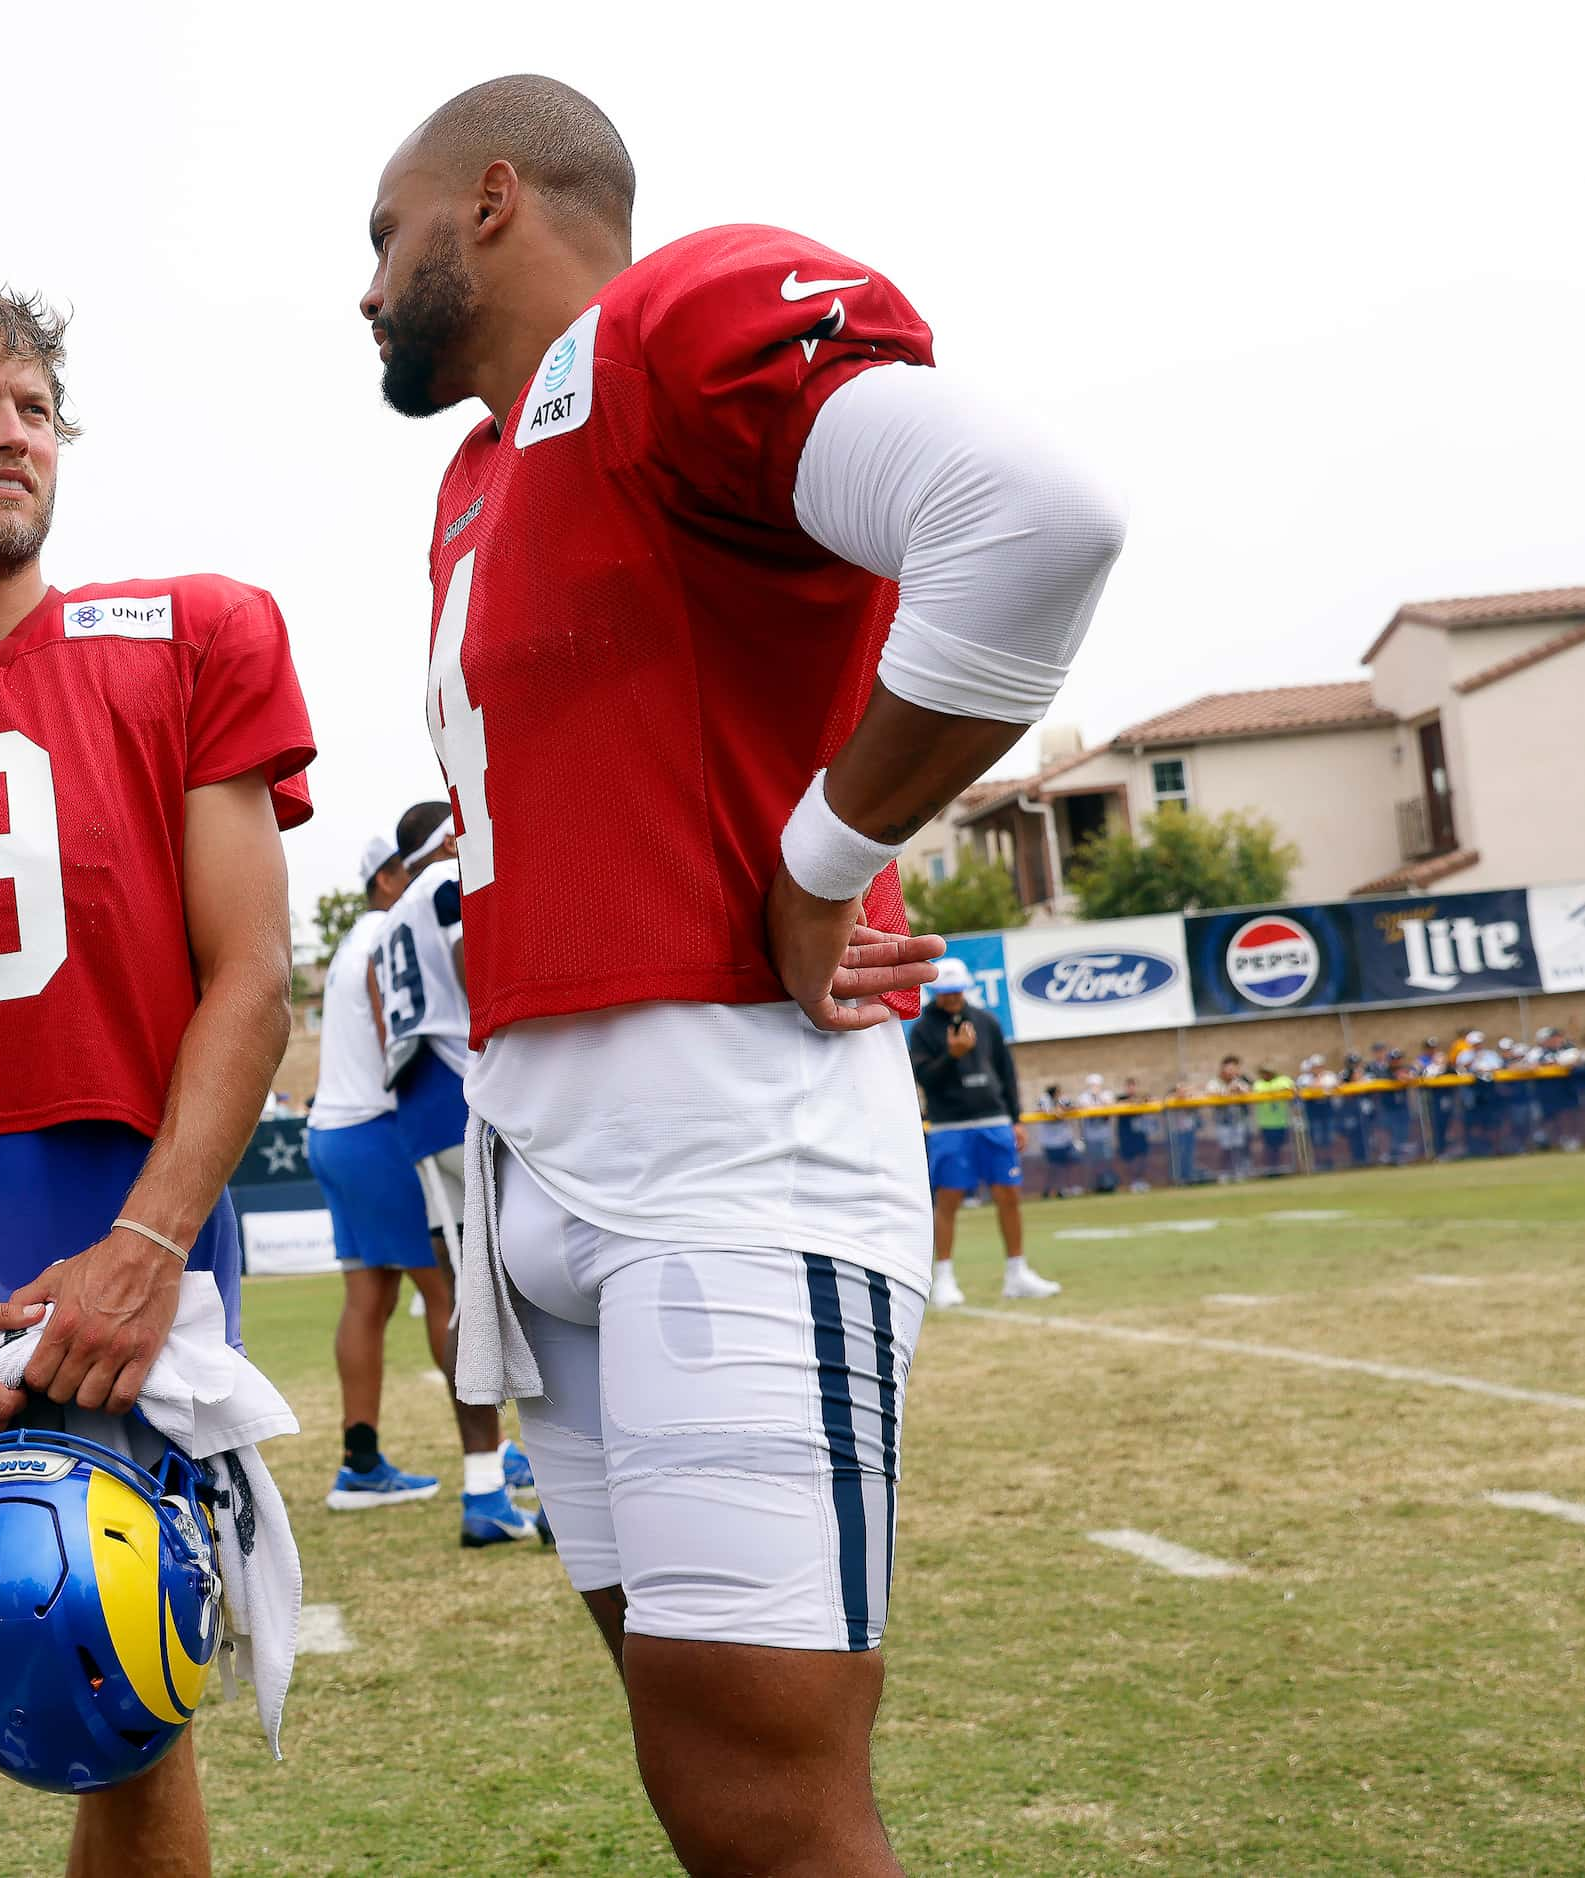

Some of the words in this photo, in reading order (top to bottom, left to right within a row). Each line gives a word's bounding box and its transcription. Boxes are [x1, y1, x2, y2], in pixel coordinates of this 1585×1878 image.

[530, 392, 575, 431] AT&T
[112, 607, 166, 622] UNIFY
[426, 547, 495, 896] 4
[1045, 954, 1149, 1001] Ford
[1236, 951, 1310, 971] PEPSI
[1398, 916, 1521, 992] Lite
[374, 922, 426, 1038] 9
